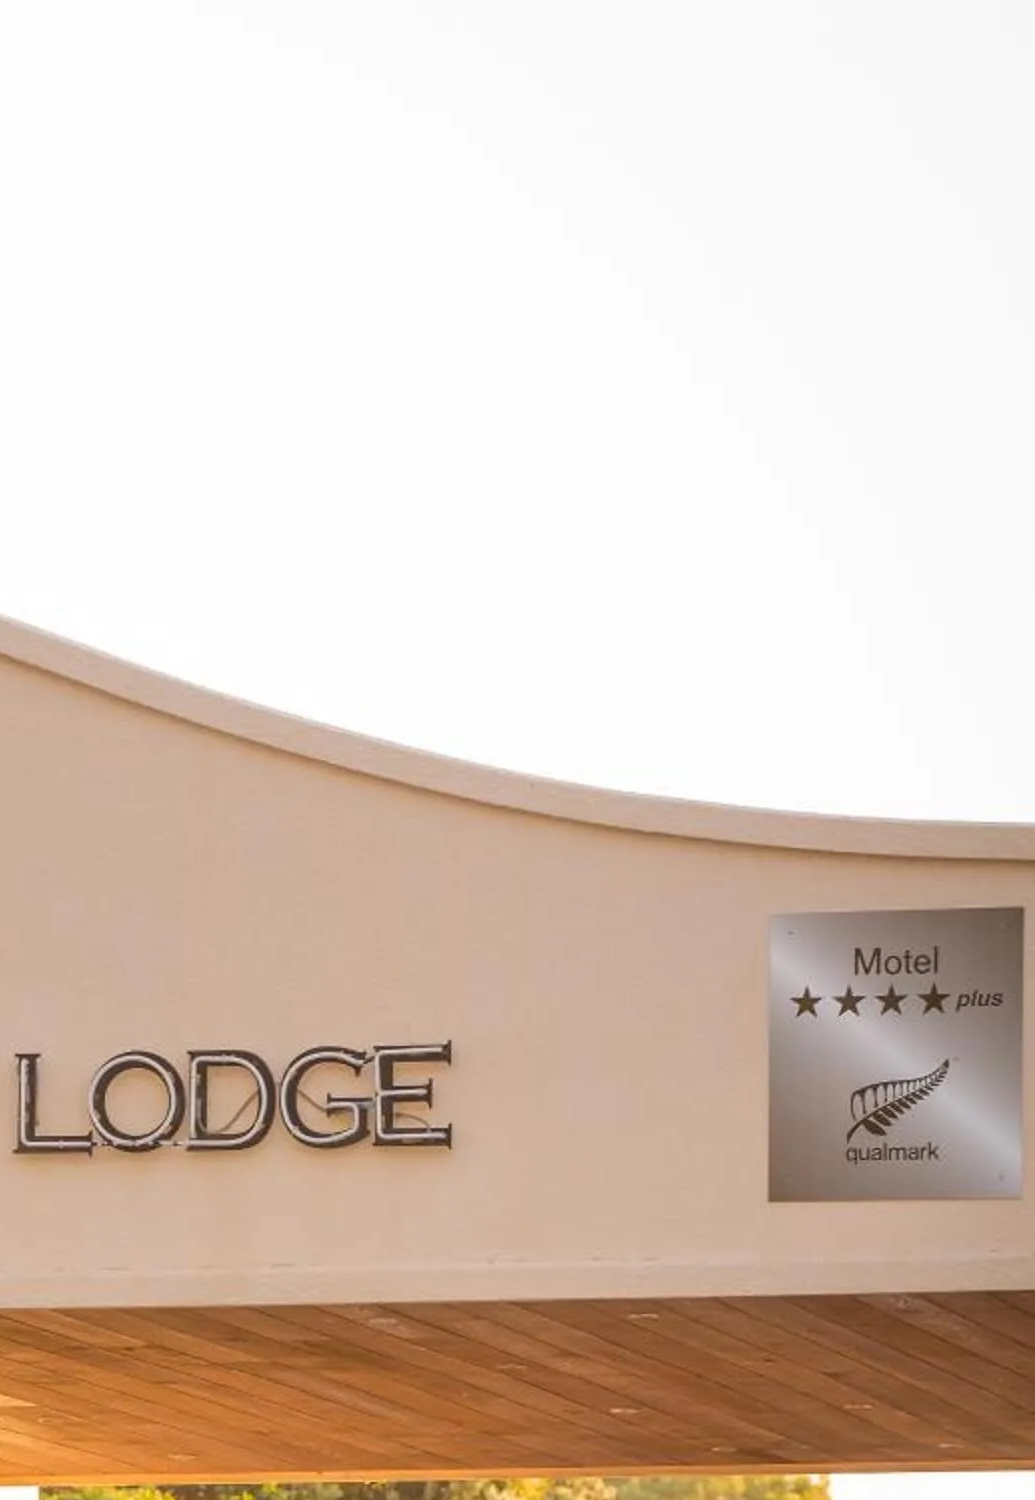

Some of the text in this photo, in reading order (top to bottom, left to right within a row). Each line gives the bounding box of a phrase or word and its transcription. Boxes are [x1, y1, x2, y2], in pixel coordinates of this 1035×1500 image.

[853, 946, 939, 975] Motel
[956, 990, 1004, 1012] plus
[13, 1040, 452, 1154] LODGE
[846, 1142, 939, 1164] qualmark
